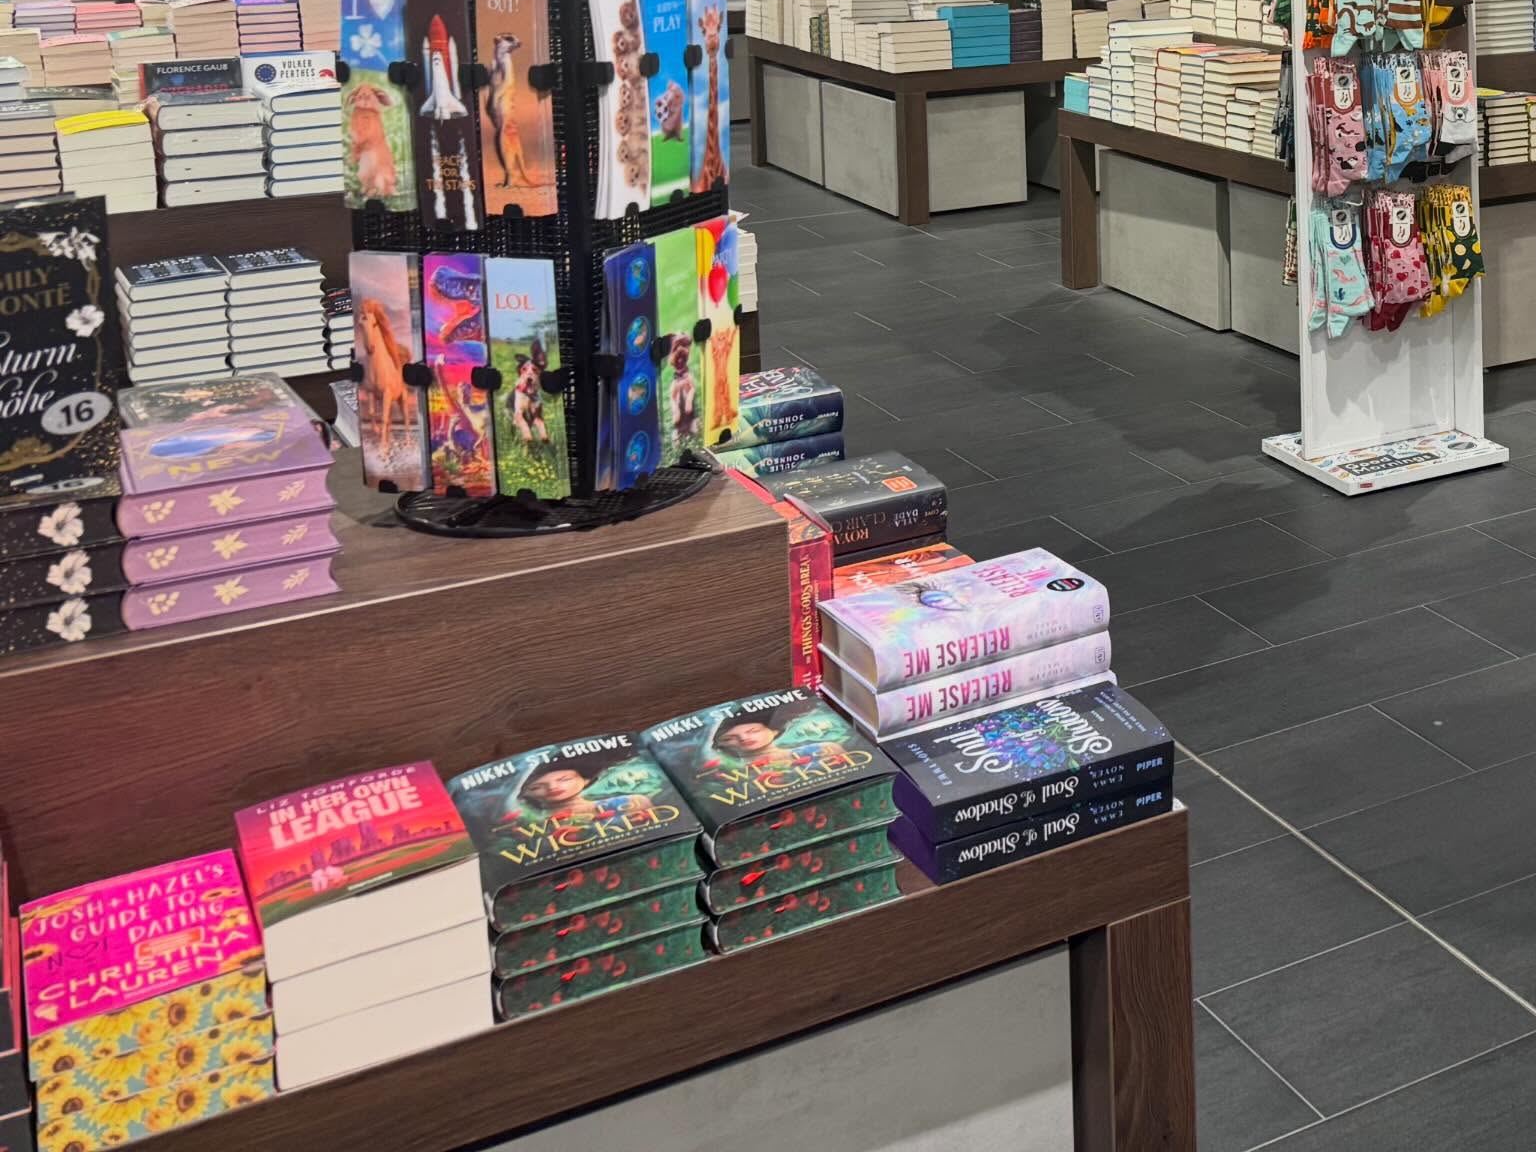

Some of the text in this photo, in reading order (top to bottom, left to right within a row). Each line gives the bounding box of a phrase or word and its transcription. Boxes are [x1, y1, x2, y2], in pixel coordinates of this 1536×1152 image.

[653, 15, 682, 34] PLAY
[156, 62, 229, 75] FLORENCE GAUB
[280, 68, 316, 79] PERTHES
[281, 59, 312, 68] VOLKER
[494, 291, 536, 312] LOL
[62, 397, 95, 426] 16
[758, 413, 804, 429] JOHNSON
[815, 410, 839, 419] Forever
[769, 421, 795, 433] JULIE
[759, 451, 805, 468] JOHNSON
[769, 462, 796, 473] JULIE
[817, 449, 840, 458] Forever
[845, 511, 887, 530] CLAIR
[893, 508, 919, 521] DADE
[894, 517, 919, 528] AYLA
[971, 564, 1031, 599] RELEASE
[799, 585, 814, 614] GODS
[799, 615, 814, 657] THINGS
[936, 625, 1012, 667] RELEASE
[904, 650, 934, 678] ME
[938, 668, 1012, 712] RELEASE
[651, 689, 809, 743] NIKKI ST. CROWE
[906, 694, 934, 723] ME
[934, 727, 1014, 774] Soul
[1036, 695, 1113, 755] Shadow
[460, 734, 634, 792] NIKKI ST. CROWE
[1136, 757, 1164, 772] PIPER
[255, 765, 419, 816] LIZ TOMFORDE
[709, 750, 874, 806] WICKED
[268, 774, 412, 826] IN HER OWN
[954, 775, 1079, 824] Soul of Shadow
[1136, 791, 1163, 808] PIPER
[268, 785, 424, 852] LEAGUE
[499, 805, 681, 865] WICKED
[958, 812, 1080, 864] Soul of Shadow
[34, 901, 106, 938] JOSH
[126, 862, 225, 907] HAZEL'S
[70, 890, 198, 943] GUIDE TO
[128, 900, 225, 944] DATING
[37, 929, 250, 1003] CHRISTINA
[68, 949, 225, 1010] LAUREN
